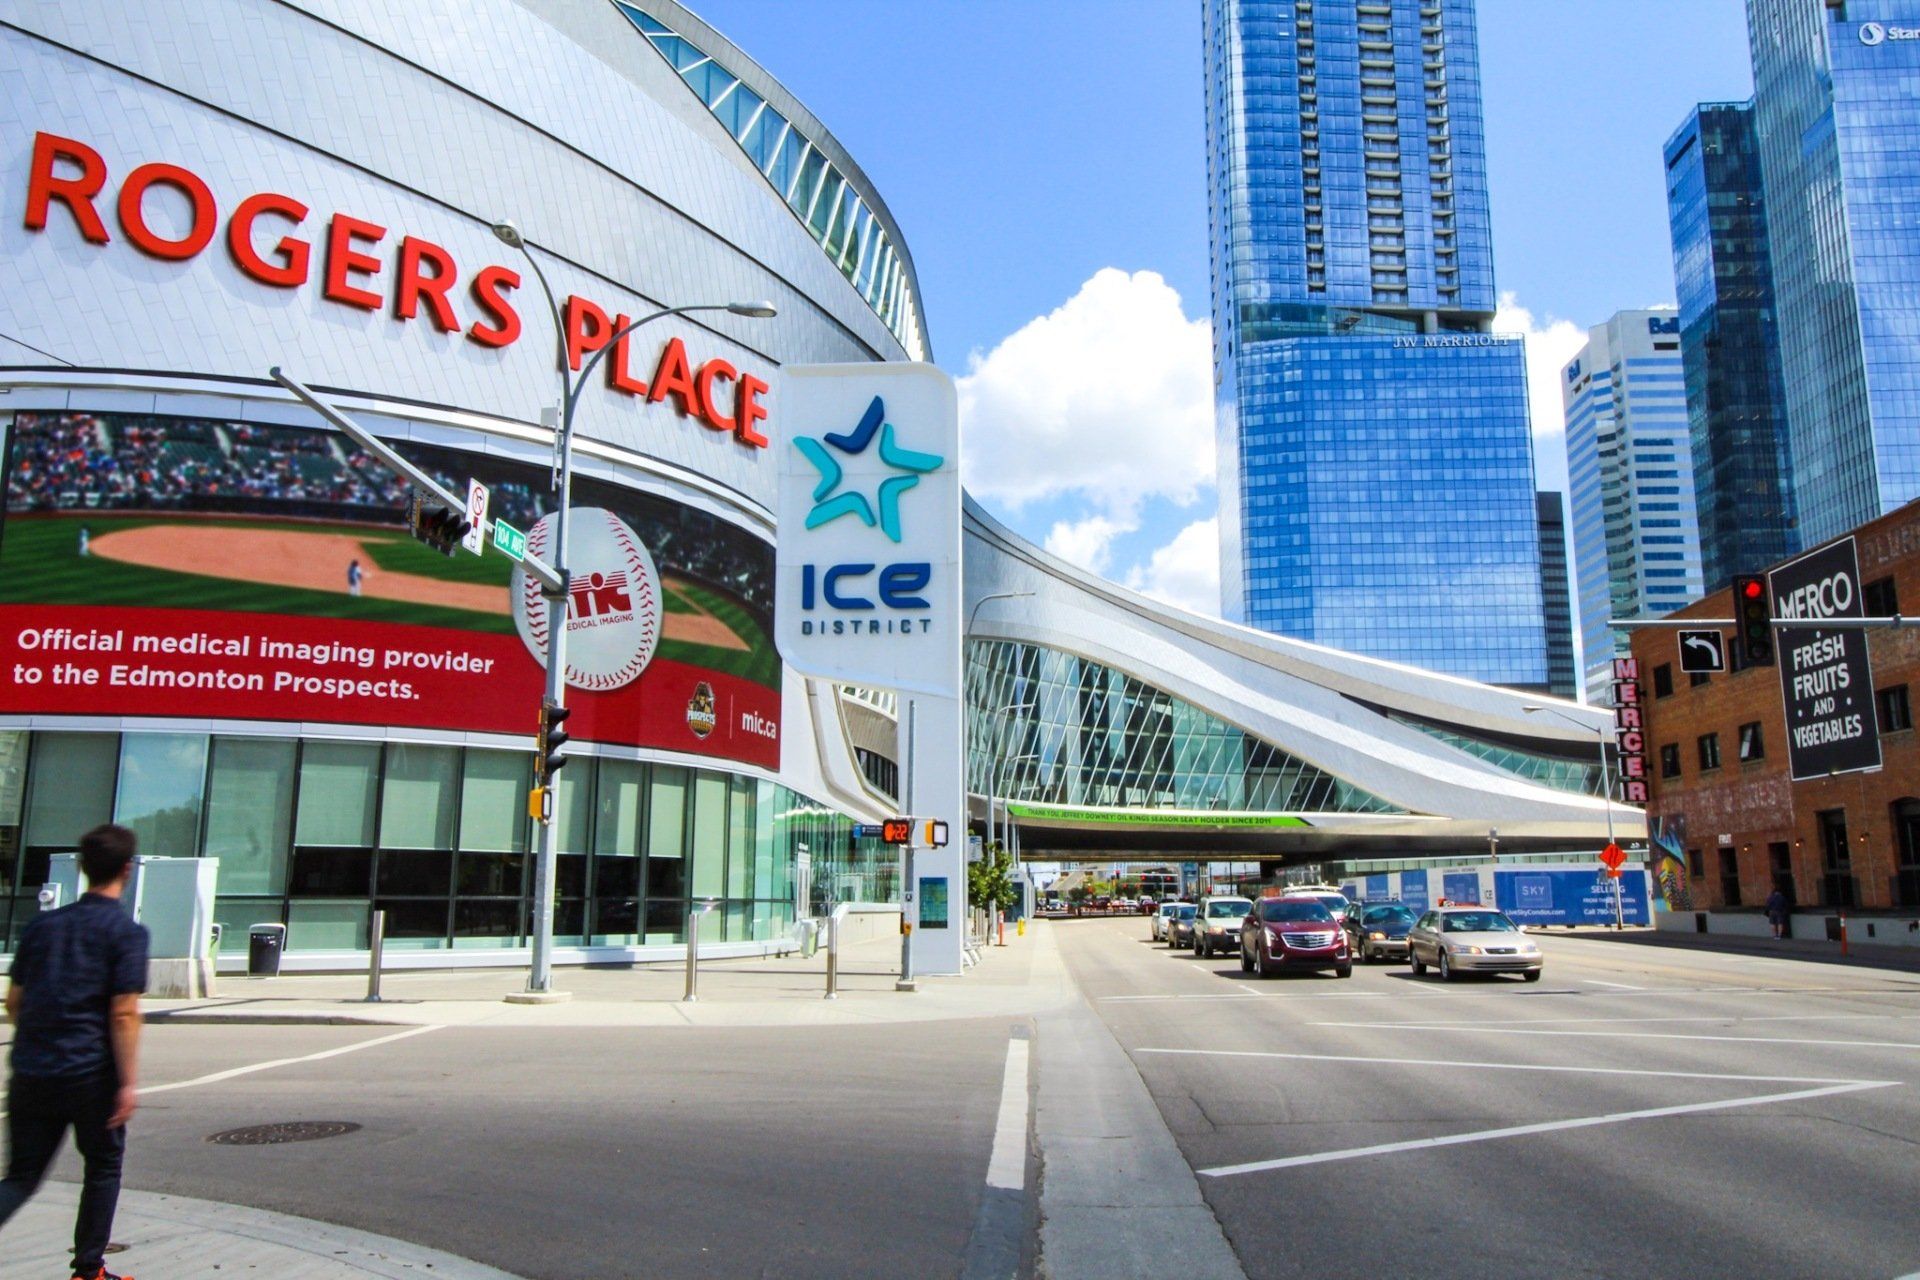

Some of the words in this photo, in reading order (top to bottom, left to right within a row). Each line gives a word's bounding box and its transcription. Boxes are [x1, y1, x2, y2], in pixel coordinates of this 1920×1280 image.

[23, 131, 522, 348] ROGERS
[561, 294, 770, 448] PLACE
[1393, 335, 1418, 348] JW
[1424, 334, 1510, 347] MARRIOTT
[1779, 572, 1852, 632] MERCO
[566, 619, 598, 631] EDICAL
[599, 613, 634, 625] IMAGING
[802, 619, 931, 635] DISTRICT
[18, 628, 123, 651] Official
[133, 633, 250, 656] medical
[260, 637, 375, 667] imaging
[384, 649, 494, 674] provider
[1793, 634, 1846, 671] FRESH
[14, 664, 43, 684] to
[52, 663, 100, 684] the
[109, 665, 264, 690] Edmonton
[274, 671, 420, 699] Prospects.
[1793, 662, 1850, 701] FRUITS
[1813, 697, 1836, 717] AND
[742, 710, 777, 739] mic.ca
[1615, 659, 1647, 801] MERCER
[1793, 714, 1863, 749] VEGETABLES
[895, 824, 907, 840] 22
[1129, 814, 1150, 822] KINGS
[1150, 815, 1178, 823] SEASON
[1180, 815, 1199, 823] SEAT
[1200, 816, 1230, 824] HOLDER
[1231, 816, 1254, 824] SINCE
[1522, 886, 1545, 896] SKY
[1591, 885, 1626, 894] SELLIG
